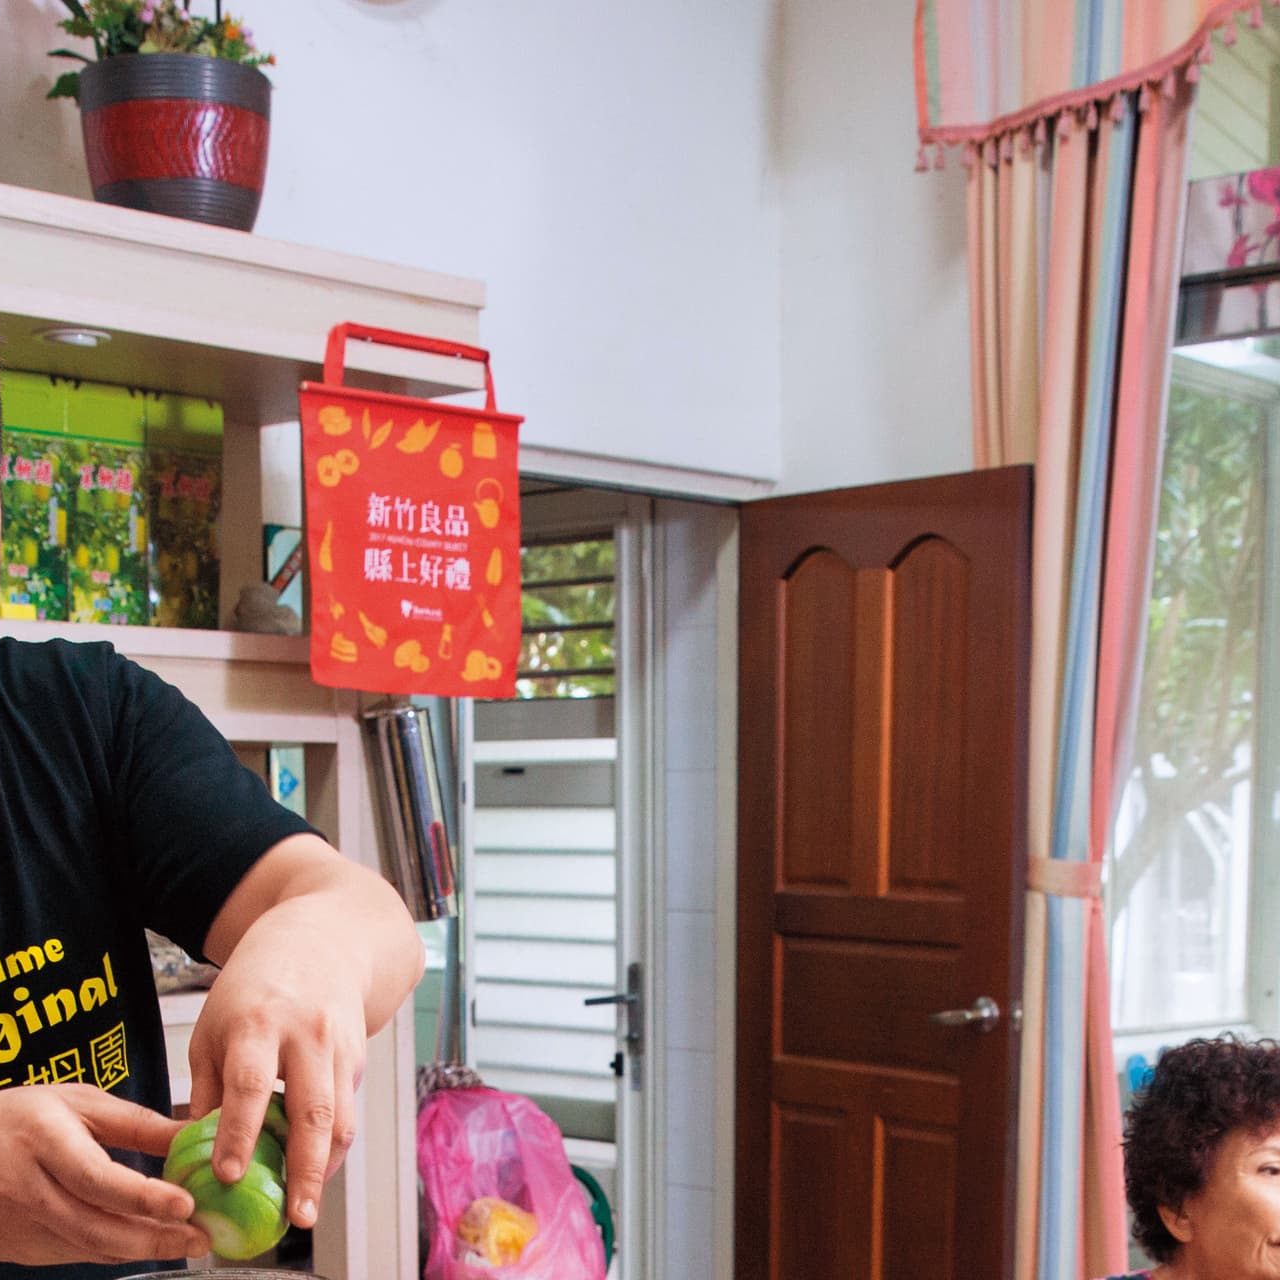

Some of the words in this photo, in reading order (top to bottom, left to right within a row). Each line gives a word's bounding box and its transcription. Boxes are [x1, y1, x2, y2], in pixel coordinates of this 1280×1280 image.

[367, 492, 470, 537] 新竹良品
[364, 548, 471, 591] 縣上好禮
